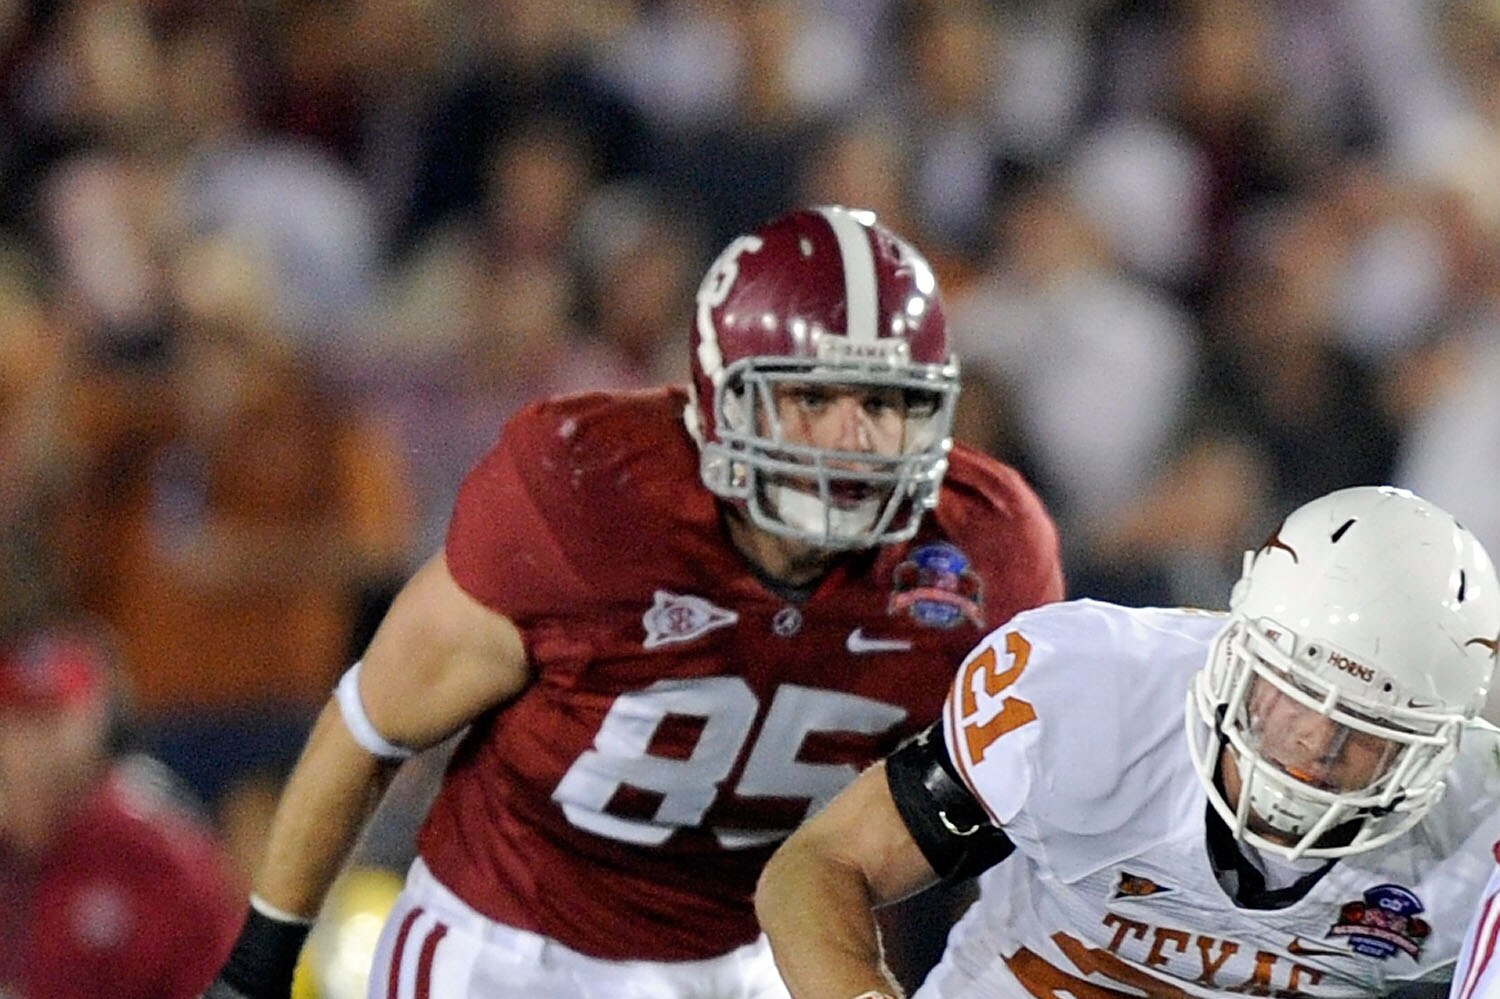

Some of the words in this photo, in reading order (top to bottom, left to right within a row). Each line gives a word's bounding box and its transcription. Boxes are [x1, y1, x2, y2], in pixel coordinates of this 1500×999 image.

[961, 631, 1039, 766] 21
[1327, 651, 1376, 684] HORNS
[553, 677, 908, 850] 85
